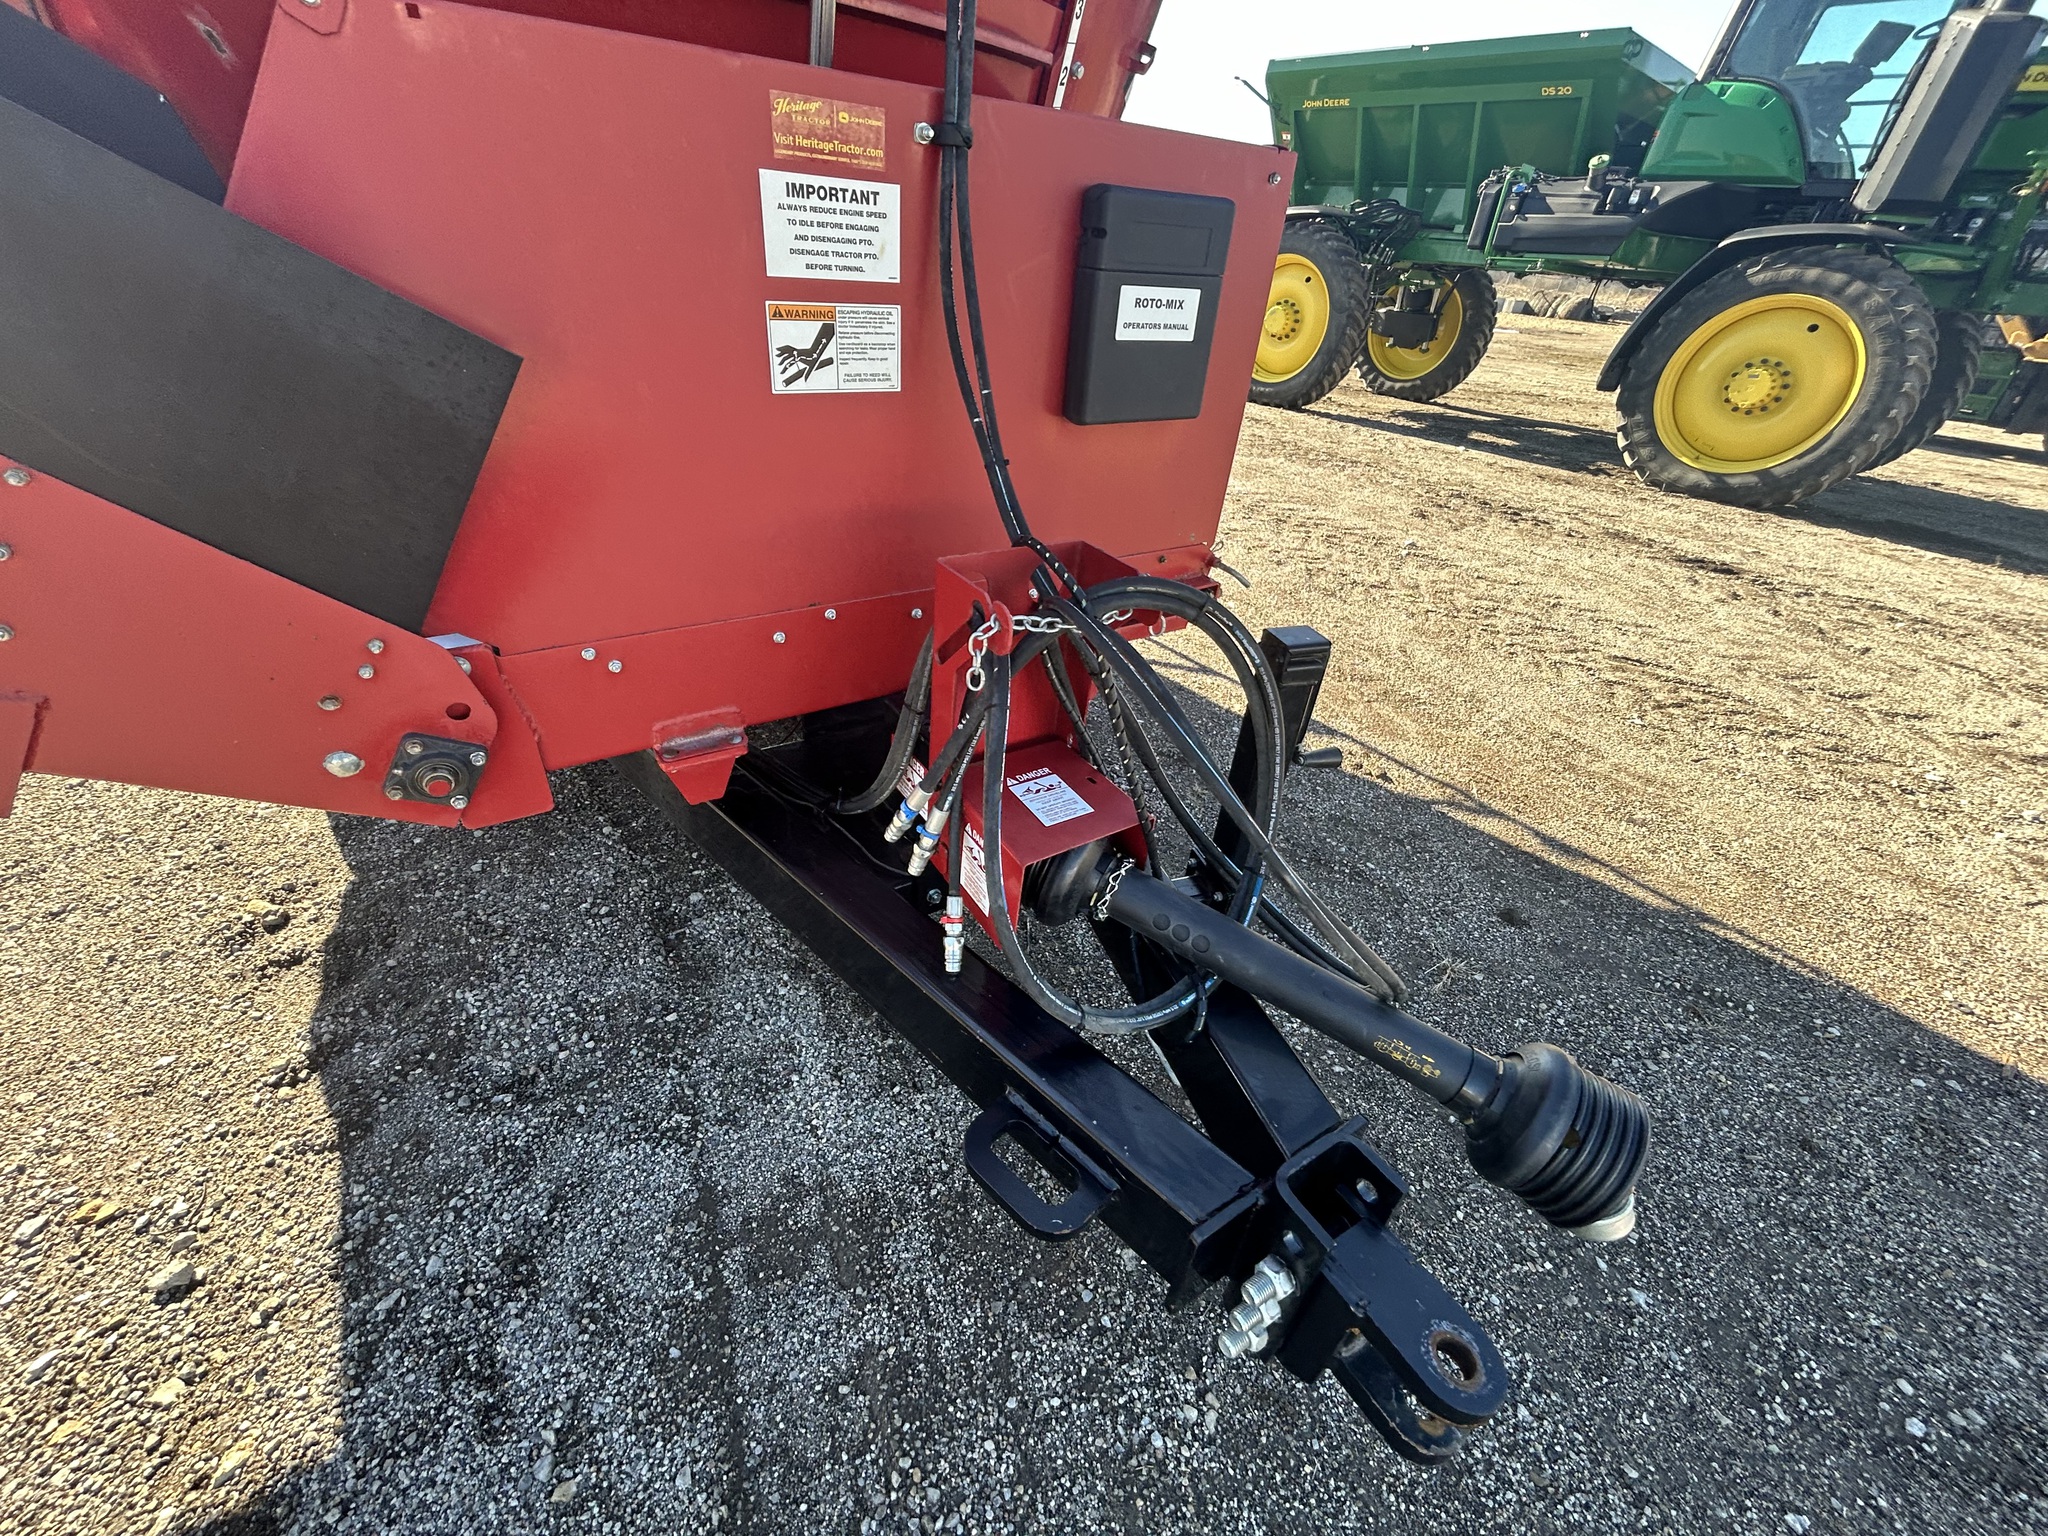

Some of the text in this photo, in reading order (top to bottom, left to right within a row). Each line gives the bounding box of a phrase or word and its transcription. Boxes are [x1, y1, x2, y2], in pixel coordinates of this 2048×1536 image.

[1059, 66, 1068, 86] 2
[1542, 87, 1572, 95] DS 20
[773, 97, 822, 116] Heritage
[1302, 100, 1322, 108] JOHN
[791, 114, 830, 125] TRACTOR
[774, 132, 884, 158] Visit HeritageTractor.com
[785, 182, 880, 206] IMPORTANT
[777, 203, 887, 219] ALWAYS REDUCE ENGINE SPEED
[799, 220, 814, 228] IDLE
[816, 221, 844, 230] BEFORE
[845, 223, 879, 233] ENGAGING
[811, 235, 857, 245] DISENGAGING
[859, 238, 874, 246] PTO.
[789, 248, 879, 260] DISENGAGE TRACTOR PTO.
[834, 264, 865, 273] TURNING.
[1134, 297, 1185, 310] ROTO-MIX
[784, 309, 834, 319] WARNING
[1123, 322, 1189, 331] OPERATORS MANUAL
[1015, 767, 1052, 782] DANGER
